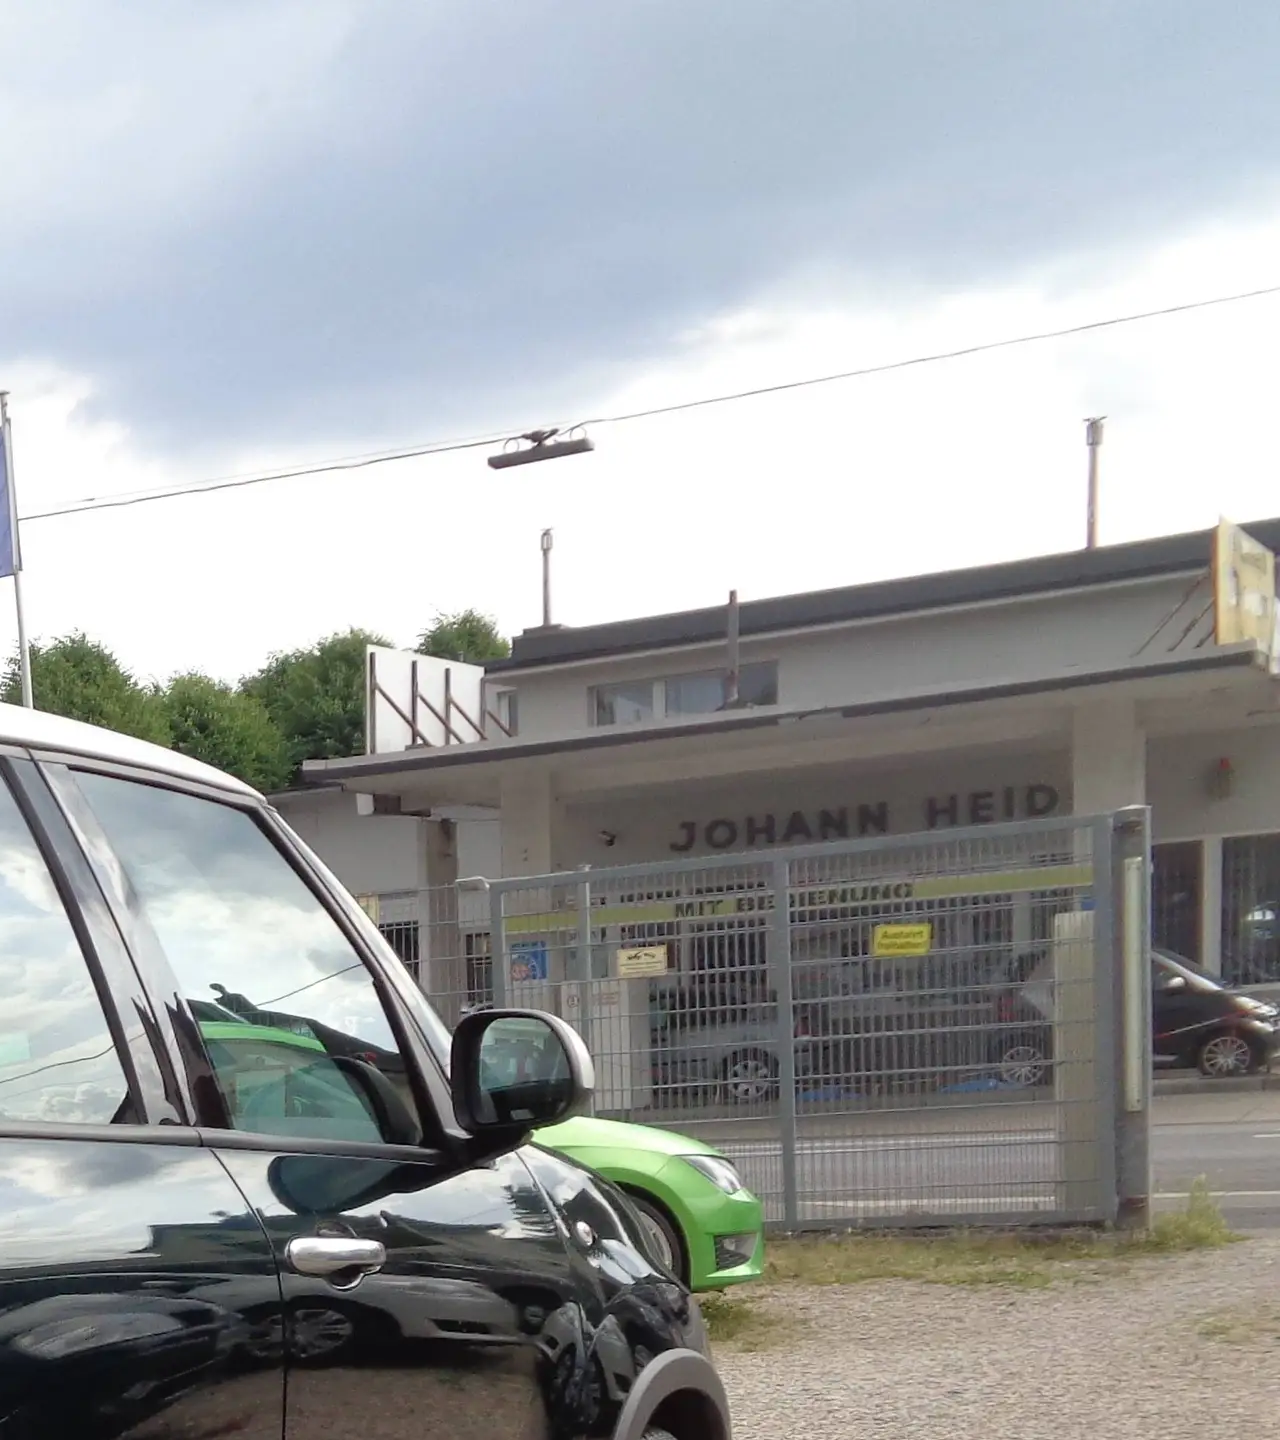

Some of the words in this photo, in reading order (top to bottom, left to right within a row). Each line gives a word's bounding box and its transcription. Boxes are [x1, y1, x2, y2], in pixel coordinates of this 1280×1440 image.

[669, 801, 890, 852] JOHANN
[927, 783, 1060, 829] HEID
[674, 899, 723, 919] MIT
